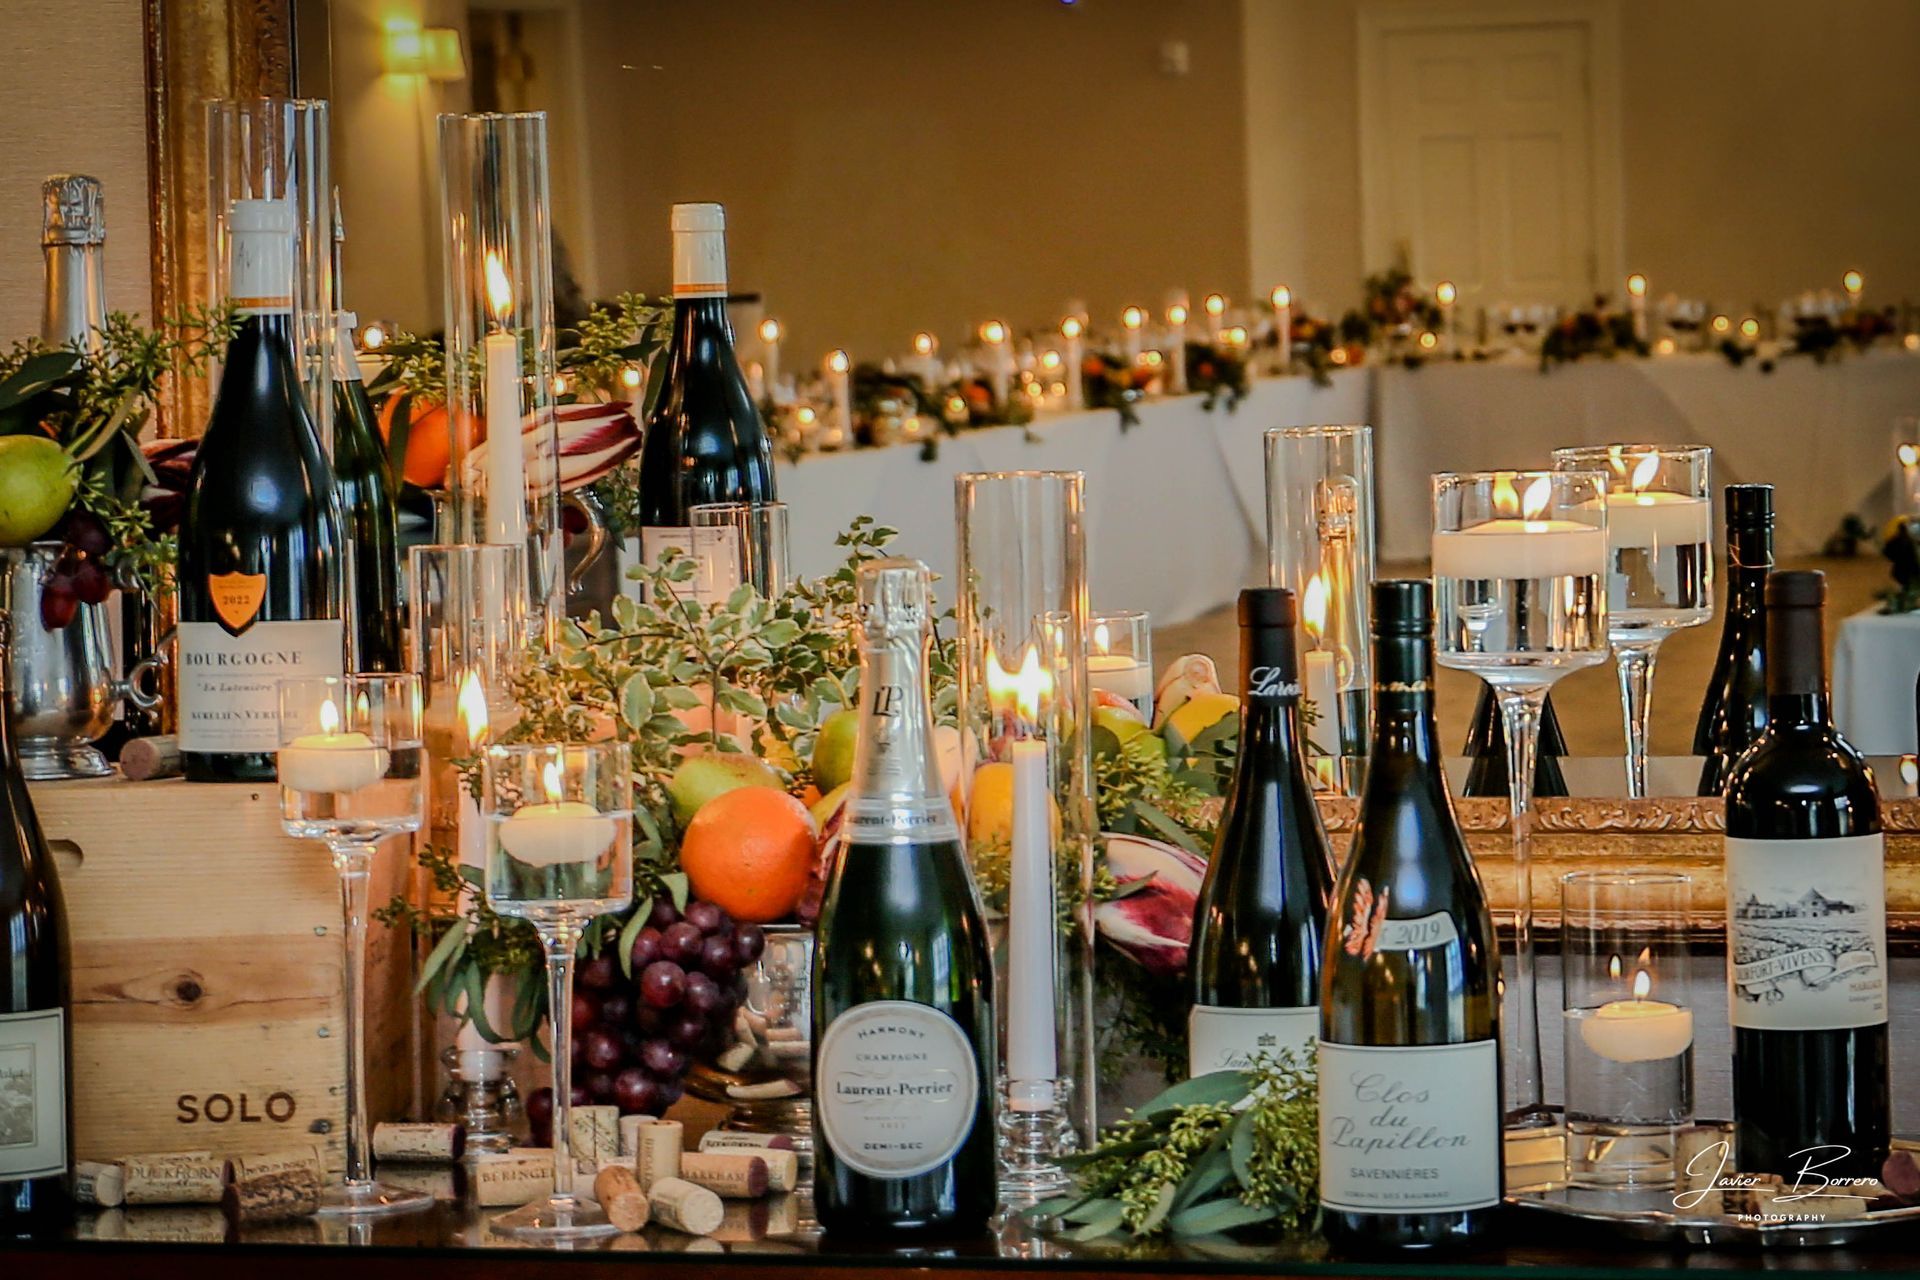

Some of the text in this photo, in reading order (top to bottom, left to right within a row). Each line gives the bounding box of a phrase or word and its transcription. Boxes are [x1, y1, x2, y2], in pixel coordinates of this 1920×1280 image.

[185, 651, 302, 667] BOURGOGNE
[1394, 920, 1441, 944] 2019
[857, 1025, 926, 1040] HARMONY
[856, 1052, 928, 1062] CHAMPAGNE
[836, 1081, 953, 1096] Laurent-Perrier
[1350, 1071, 1430, 1104] Clos
[176, 1091, 297, 1124] SOLO
[1369, 1106, 1409, 1129] du
[1329, 1116, 1470, 1156] Papillon
[864, 1142, 923, 1150] DEMI-SEC
